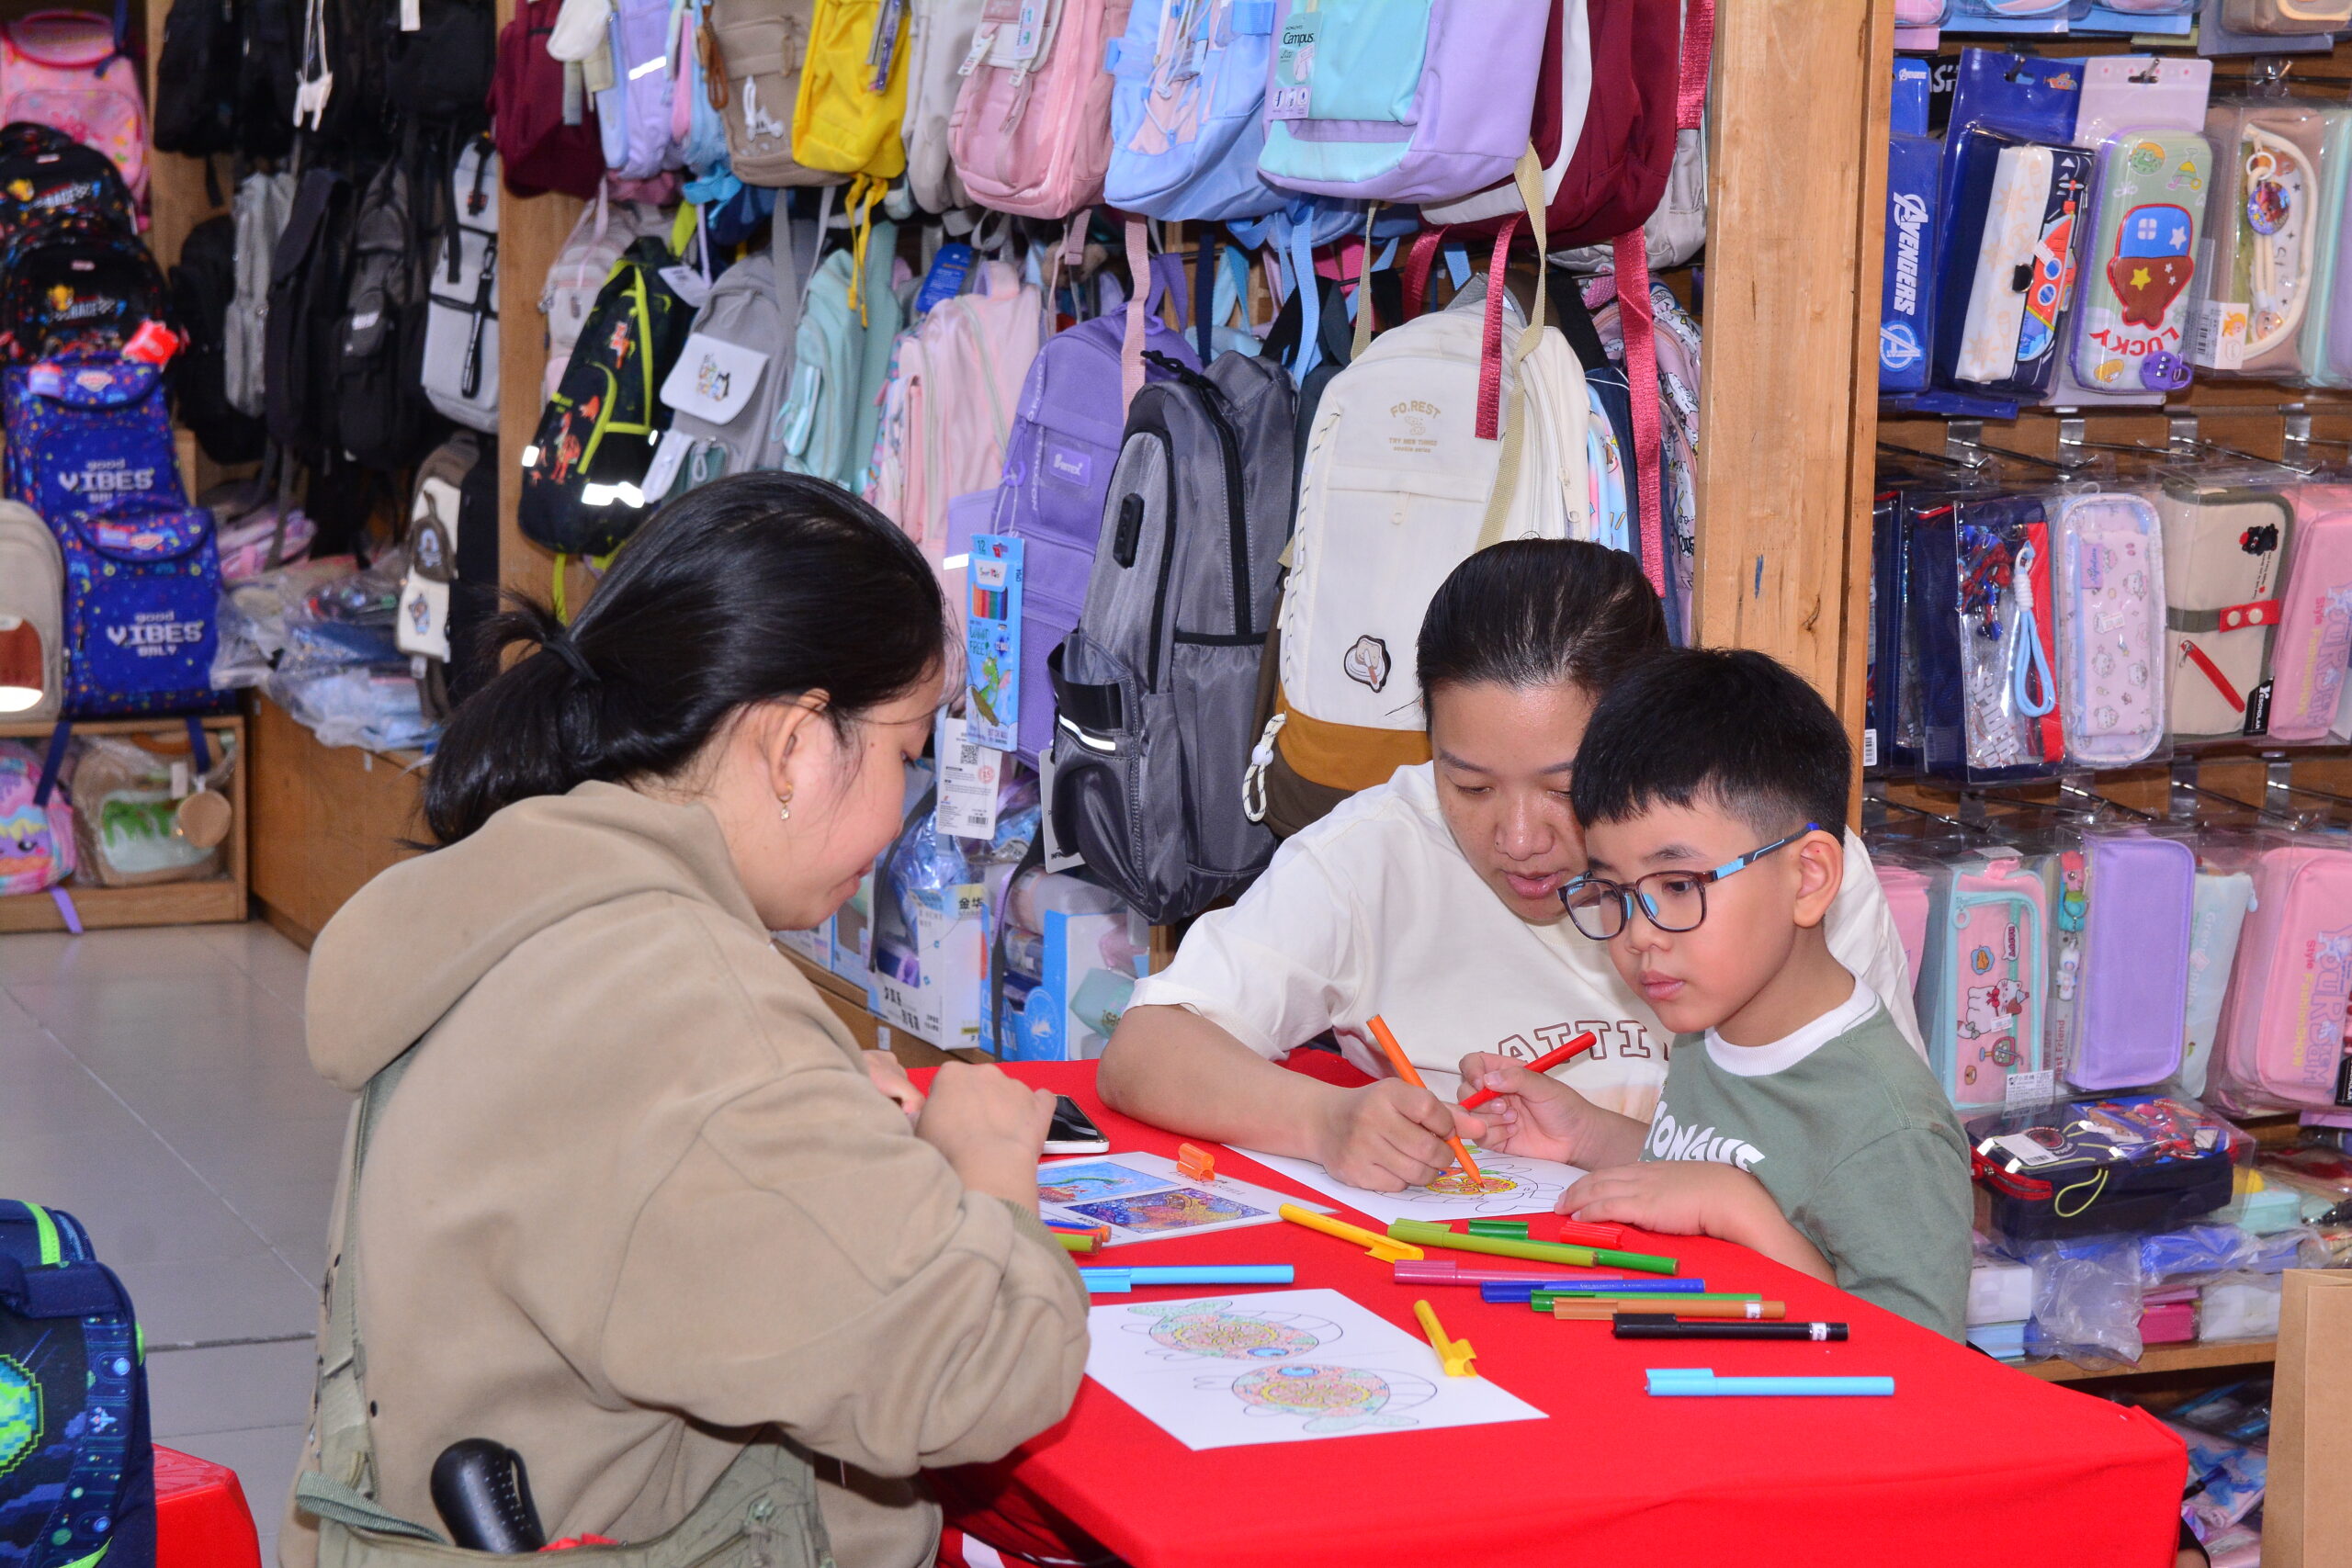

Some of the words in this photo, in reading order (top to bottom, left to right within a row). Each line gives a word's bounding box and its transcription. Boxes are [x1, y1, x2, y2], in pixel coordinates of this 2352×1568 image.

[1283, 32, 1315, 47] Campus
[1893, 191, 1929, 317] AVENGERS
[2088, 325, 2180, 357] LUCKY
[58, 469, 154, 492] VIBES
[106, 621, 202, 646] VIBES
[1970, 670, 2020, 761] SPIDER
[2255, 684, 2271, 729] YESCHOLAR
[2007, 926, 2017, 957] HAPPY
[2304, 939, 2317, 970] Style
[1480, 1019, 1669, 1065] ATTI
